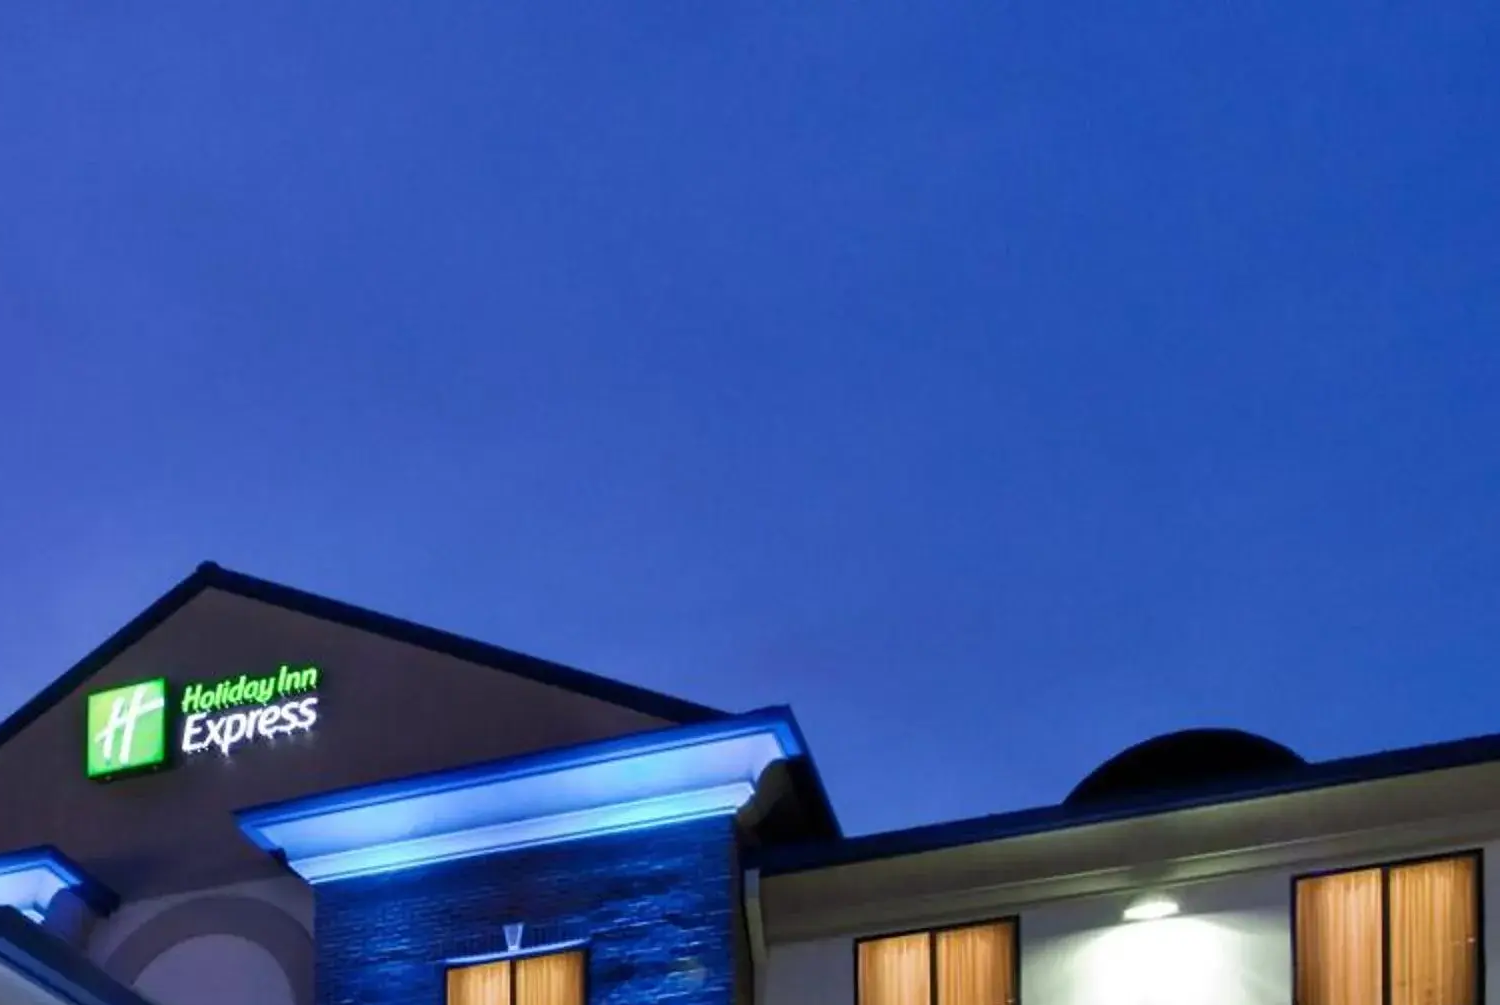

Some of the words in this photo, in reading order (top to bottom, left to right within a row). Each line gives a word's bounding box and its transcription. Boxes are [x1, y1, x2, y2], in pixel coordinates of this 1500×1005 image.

[181, 676, 275, 712] Holiday
[278, 665, 317, 694] Inn
[95, 684, 164, 765] H
[181, 698, 318, 755] Express
